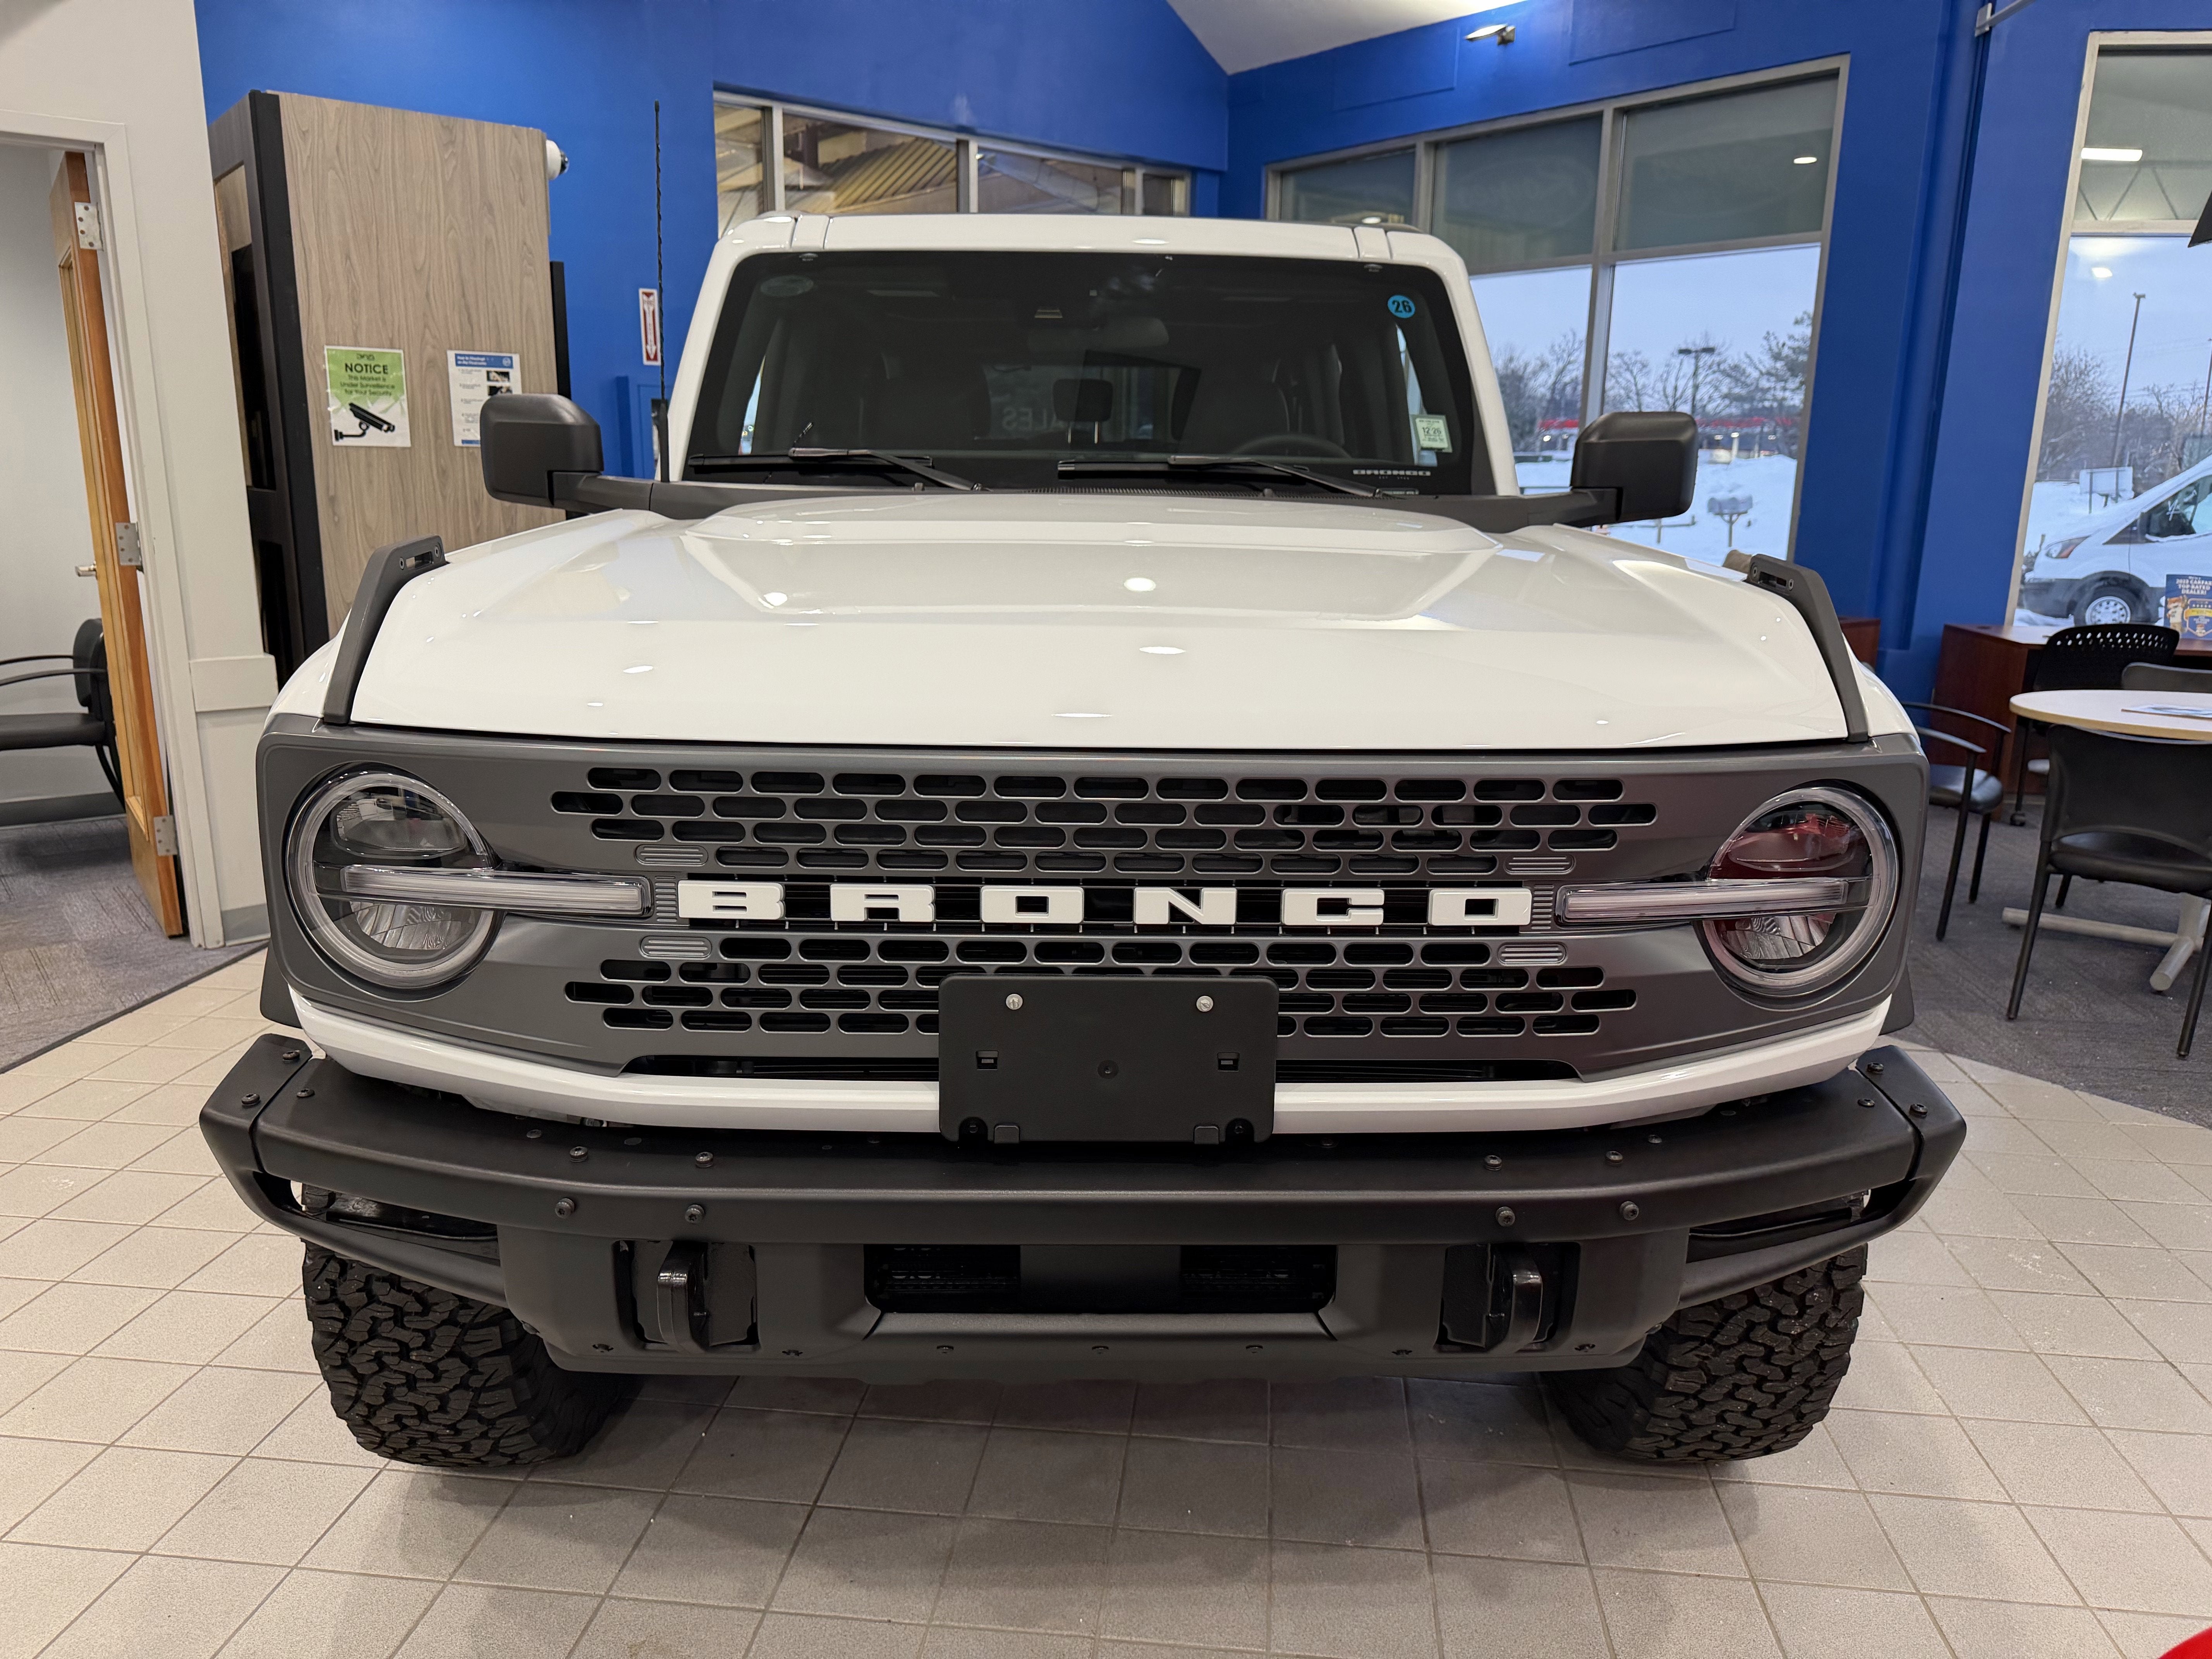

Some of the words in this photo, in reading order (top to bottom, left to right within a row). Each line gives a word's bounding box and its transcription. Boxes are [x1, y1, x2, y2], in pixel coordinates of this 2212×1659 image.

[1392, 300, 1412, 313] 26
[345, 362, 388, 374] NOTICE
[678, 880, 1532, 926] BRONCO
